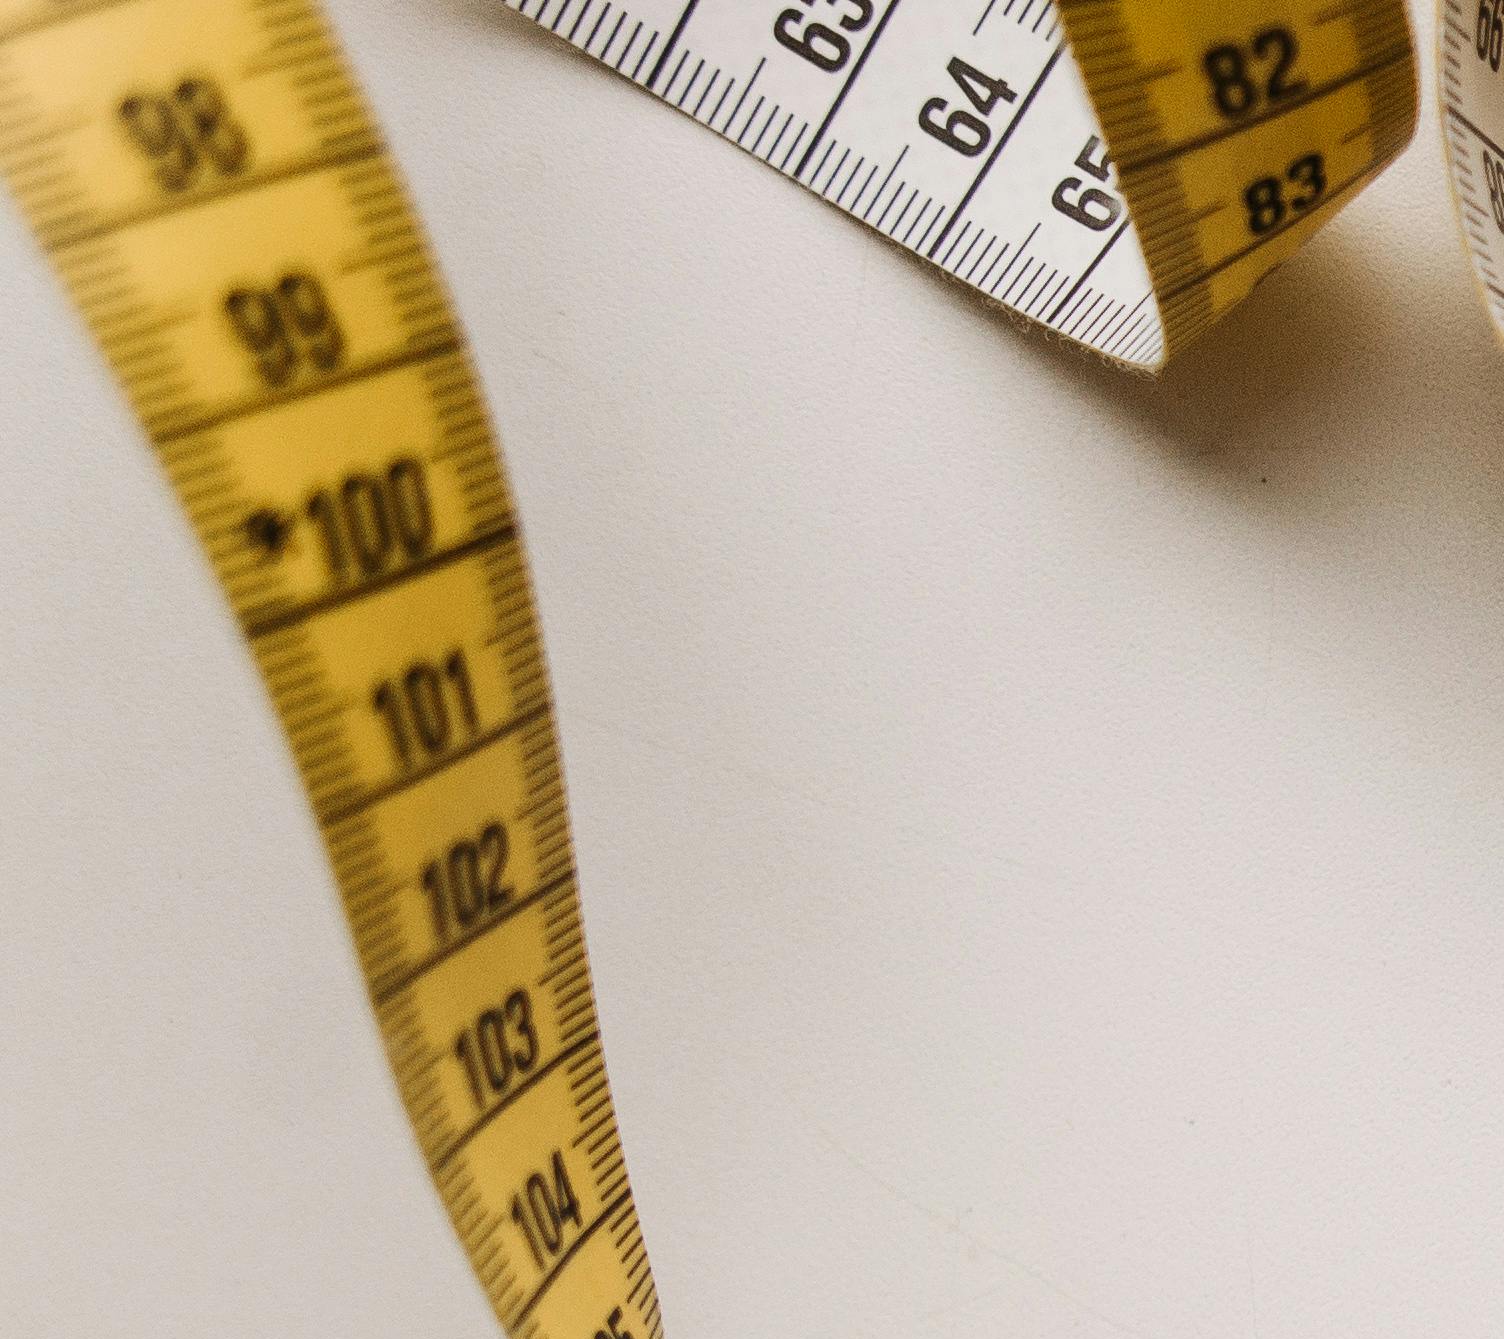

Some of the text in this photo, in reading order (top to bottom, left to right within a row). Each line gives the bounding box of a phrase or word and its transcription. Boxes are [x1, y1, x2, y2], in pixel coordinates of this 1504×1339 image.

[918, 56, 1018, 158] 64
[1204, 27, 1310, 117] 82
[1245, 153, 1328, 235] 83
[224, 268, 346, 389] 99
[306, 456, 434, 586] 100
[370, 650, 481, 769] 101
[418, 823, 517, 946] 102
[453, 988, 541, 1110] 103
[509, 1148, 583, 1272] 104
